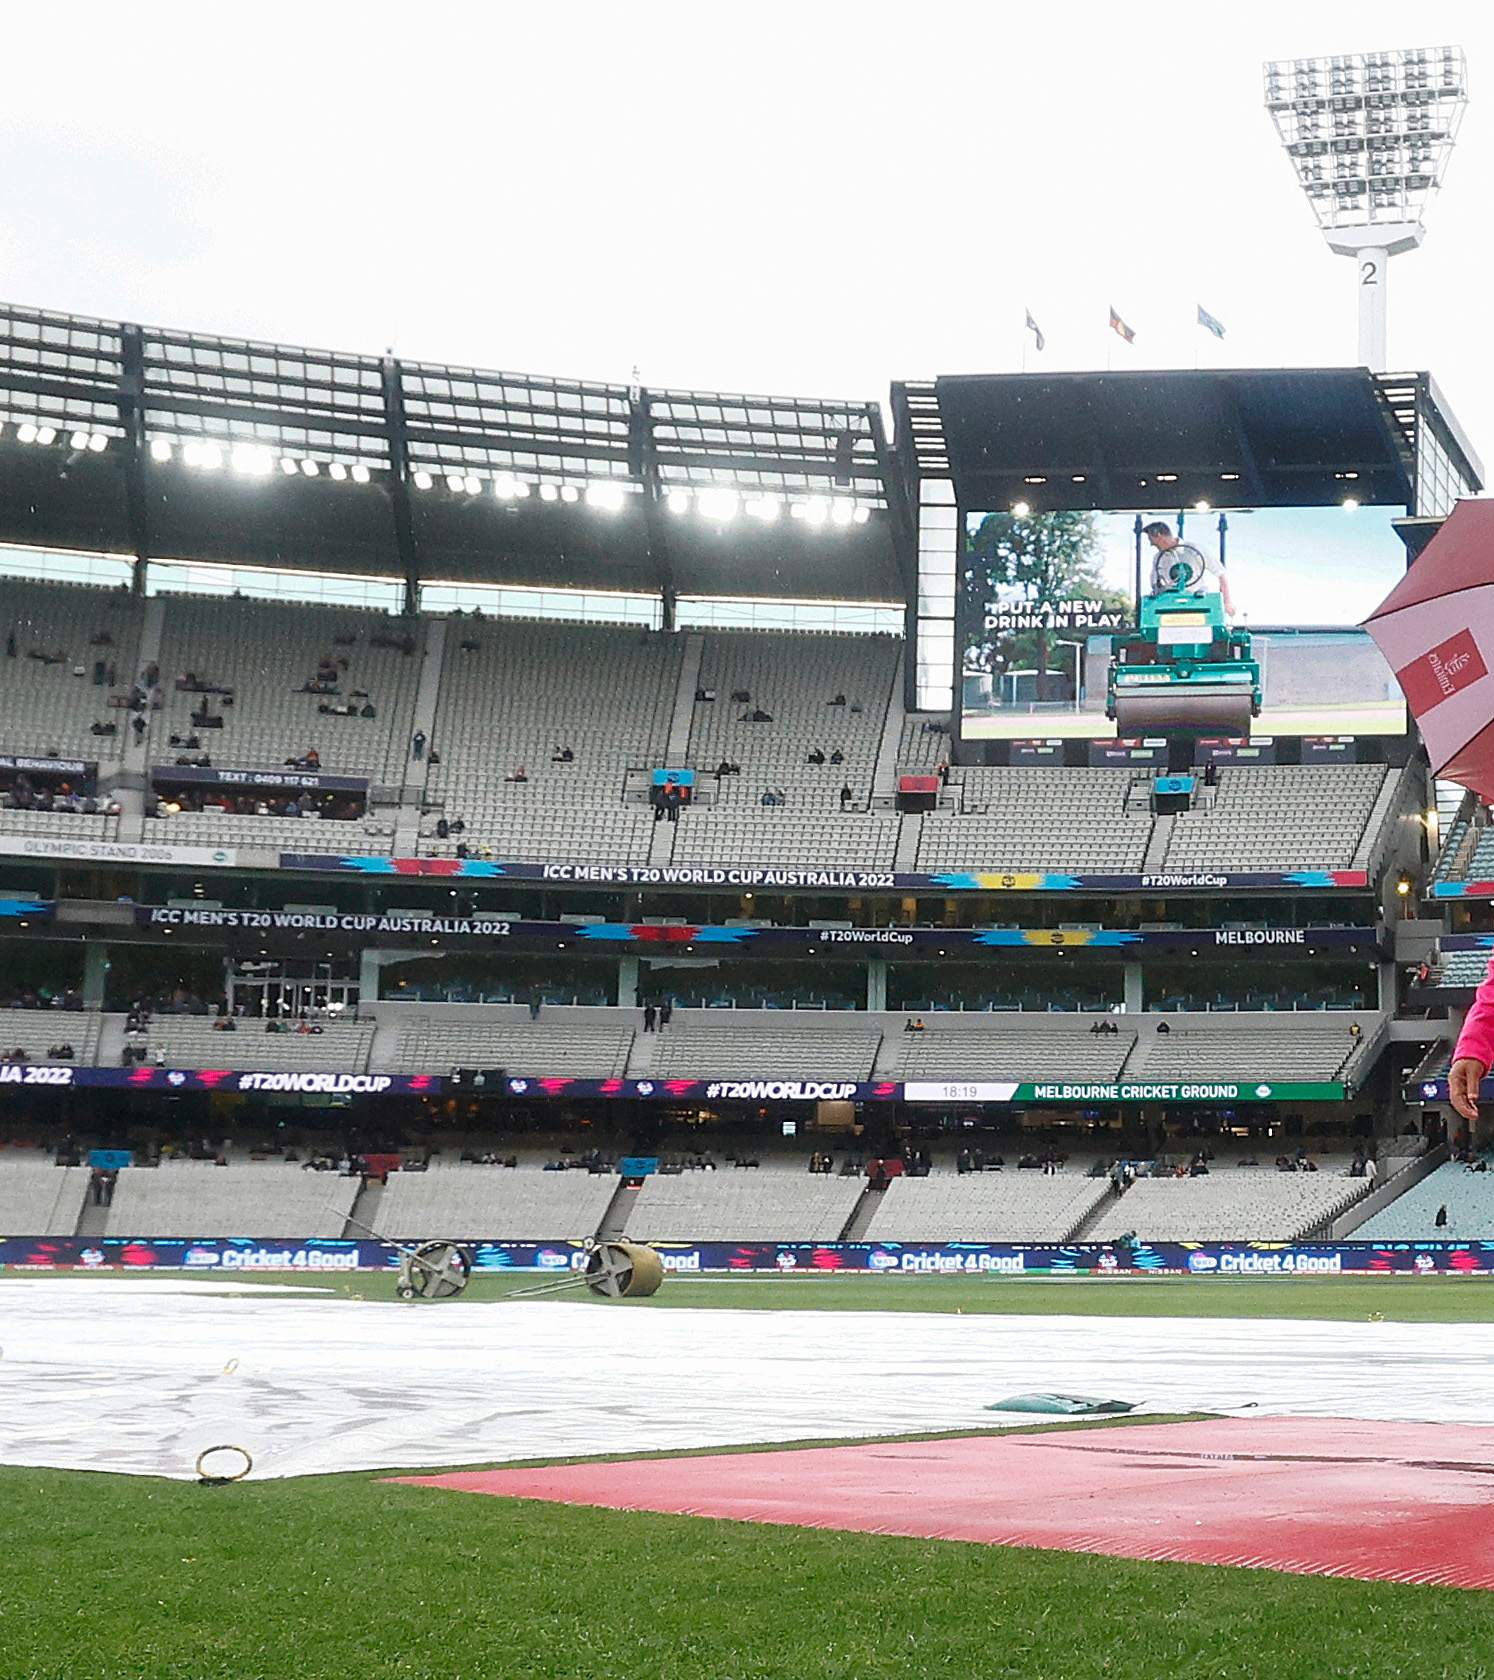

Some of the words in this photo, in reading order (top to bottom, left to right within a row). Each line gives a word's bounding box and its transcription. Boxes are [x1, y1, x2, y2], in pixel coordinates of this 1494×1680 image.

[1361, 261, 1378, 285] 2
[999, 601, 1034, 614] PUT
[1040, 601, 1054, 614] A
[1059, 600, 1103, 613] NEW
[985, 615, 1043, 629] DRINK
[1047, 615, 1068, 628] IN
[1075, 614, 1122, 627] PLAY
[24, 840, 87, 856] OLYMPIC
[91, 844, 137, 858] STAND
[543, 864, 572, 879] ICC
[574, 866, 628, 882] MEN'S
[631, 867, 660, 882] T20
[662, 868, 725, 883] WORLD
[728, 870, 763, 885] CUP
[764, 871, 856, 886] AUSTRALIA
[858, 872, 895, 887] 2022
[1142, 874, 1228, 887] #T20WorldCup
[151, 908, 180, 924] ICC
[183, 909, 237, 926] MEN'S
[241, 912, 271, 927] T20
[274, 913, 338, 929] WORLD
[340, 915, 377, 931] CUP
[378, 916, 470, 934] AUSTRALIA
[473, 920, 510, 935] 2022
[820, 930, 913, 946] #T20WorldCup
[1215, 930, 1305, 945] MELBOURNE
[24, 1066, 74, 1085] 2022
[239, 1072, 392, 1093] #T20WORLDCUP
[706, 1081, 857, 1100] #T20WORLDCUP
[942, 1085, 978, 1099] 18:19
[1034, 1085, 1119, 1100] MELBOURNE
[1121, 1084, 1177, 1099] CRICKET
[1181, 1084, 1238, 1099] GROUND
